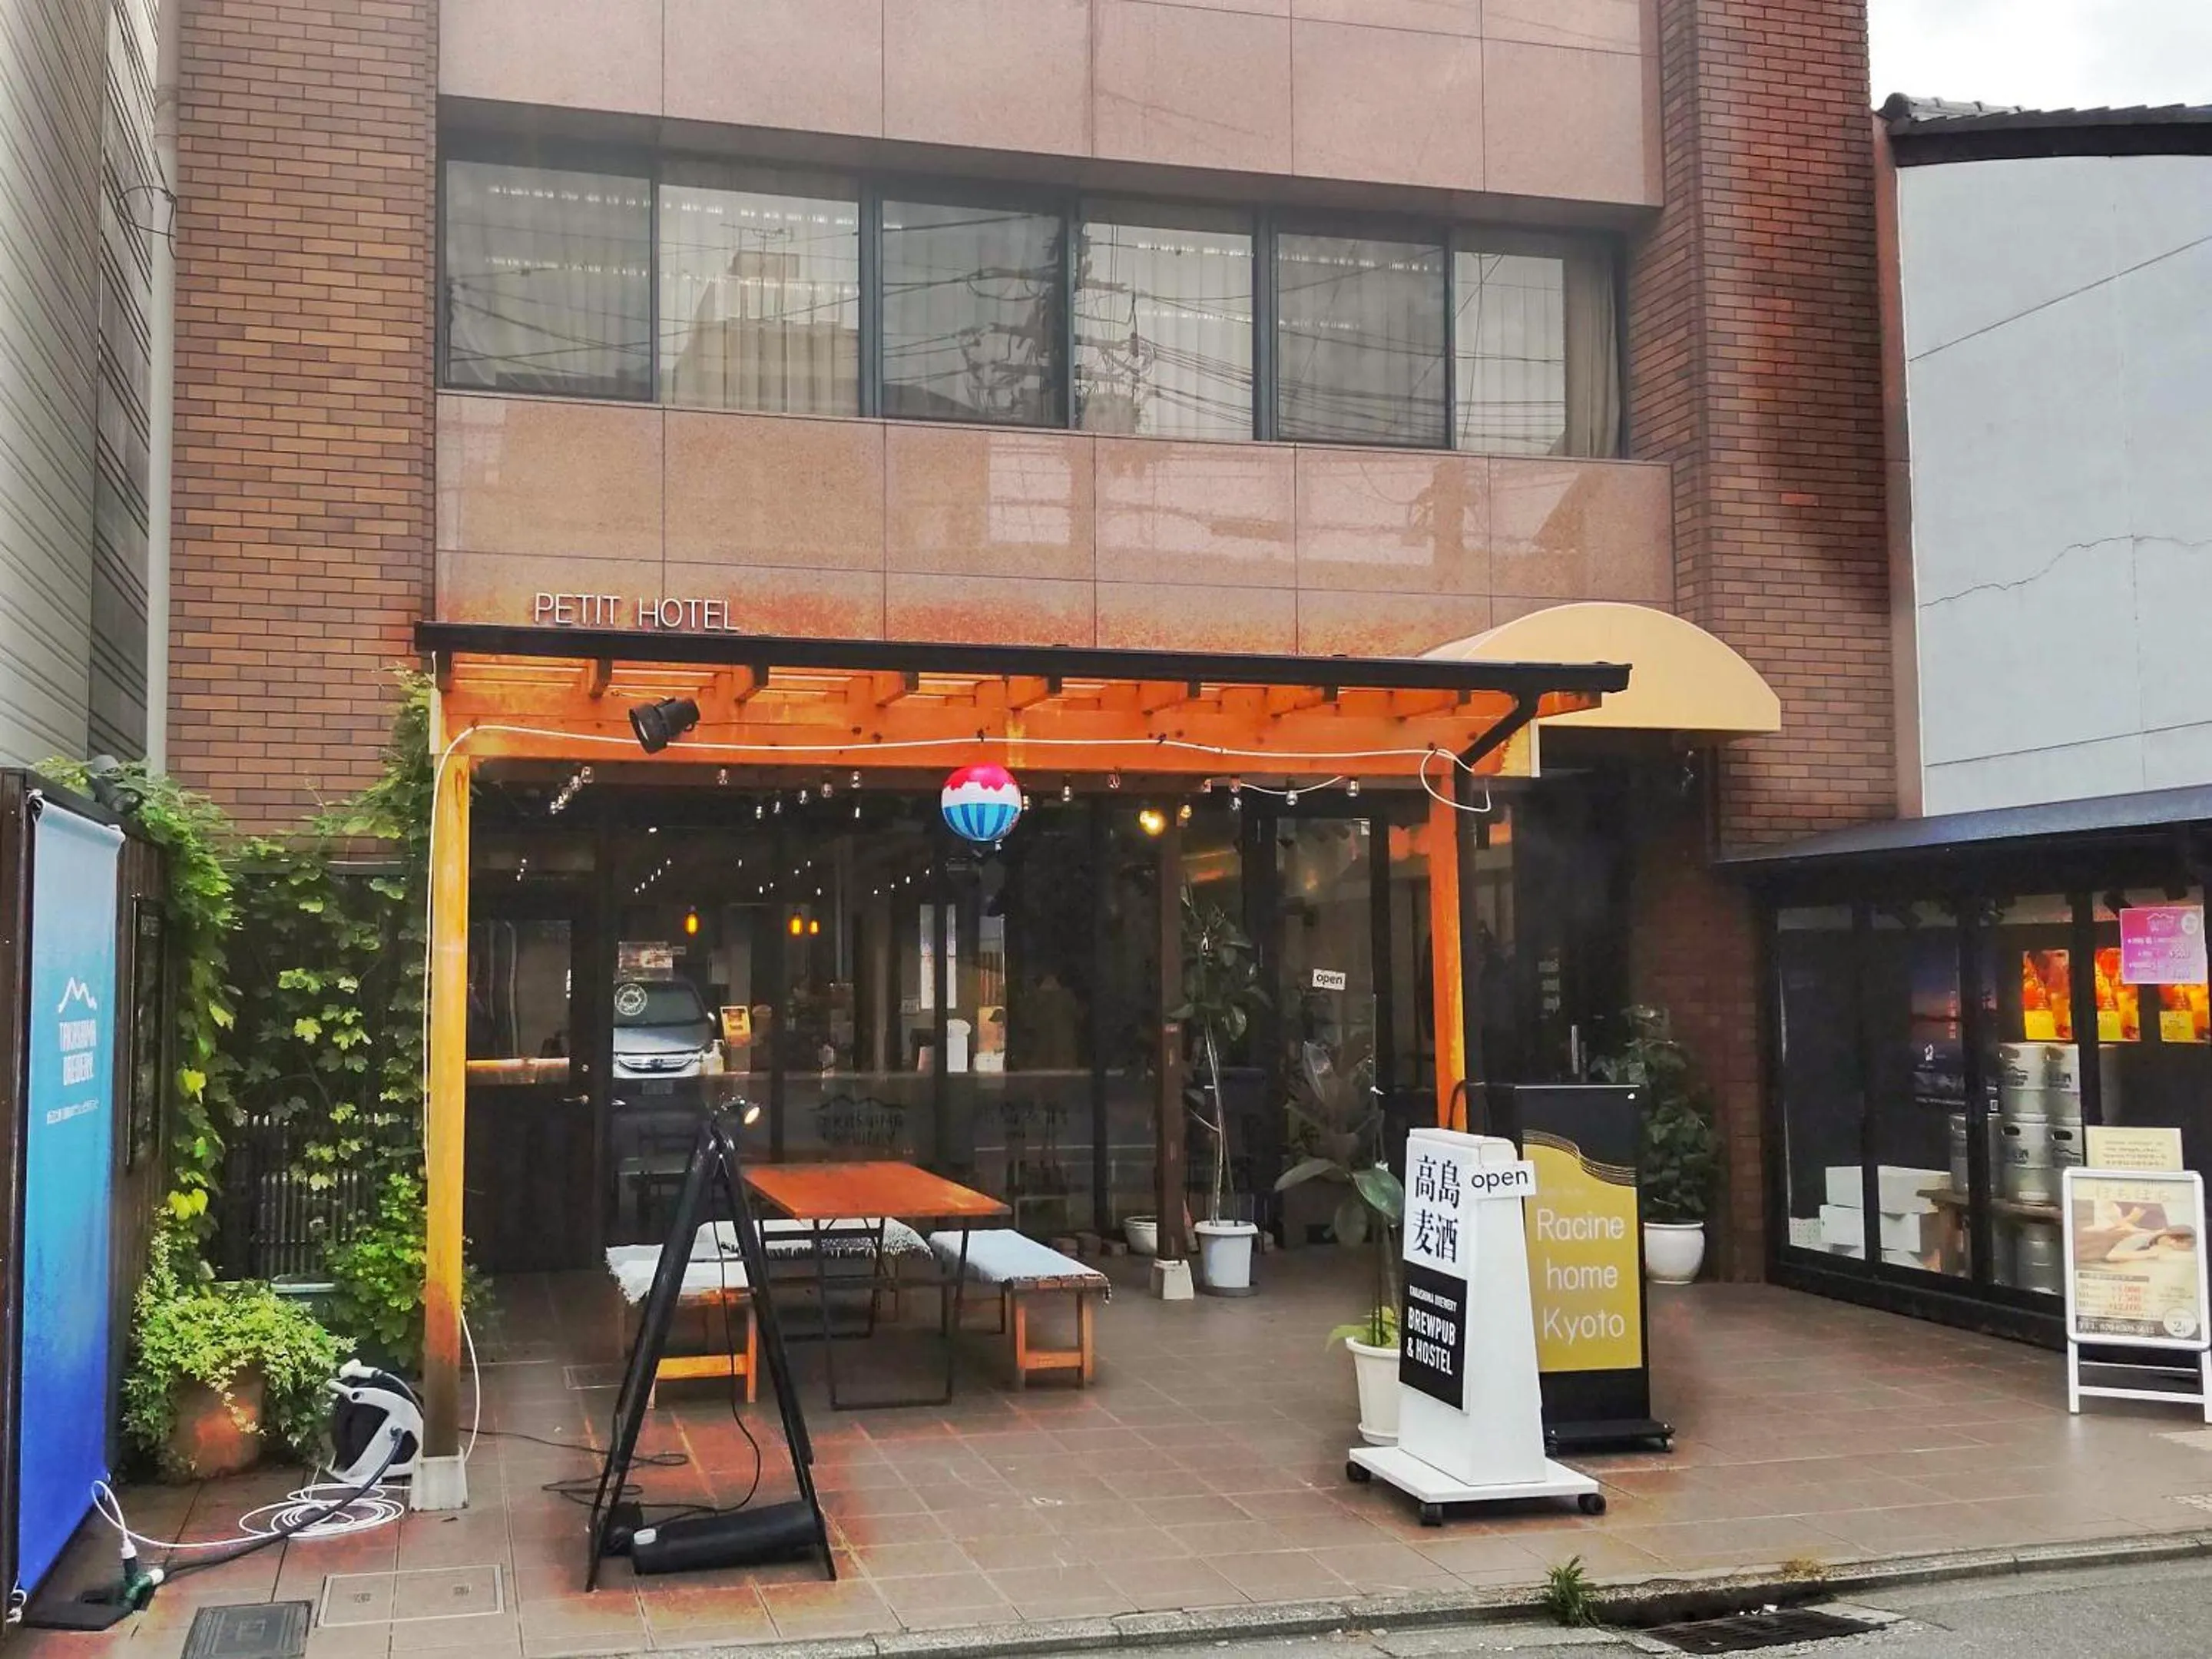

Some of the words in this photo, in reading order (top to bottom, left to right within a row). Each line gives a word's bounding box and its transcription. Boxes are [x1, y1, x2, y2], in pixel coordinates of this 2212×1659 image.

[535, 593, 621, 625] PETIT
[638, 598, 740, 631] HOTEL
[1316, 974, 1343, 985] open
[1415, 1154, 1461, 1209] 高島
[1471, 1170, 1528, 1194] open
[1412, 1209, 1459, 1263] 麦酒
[1537, 1208, 1625, 1241] Racine
[1546, 1257, 1618, 1291] home
[1407, 1306, 1456, 1346] BREWPUB
[1544, 1307, 1625, 1346] Kyoto
[1406, 1337, 1414, 1359] &
[1416, 1339, 1453, 1376] HOSTEL
